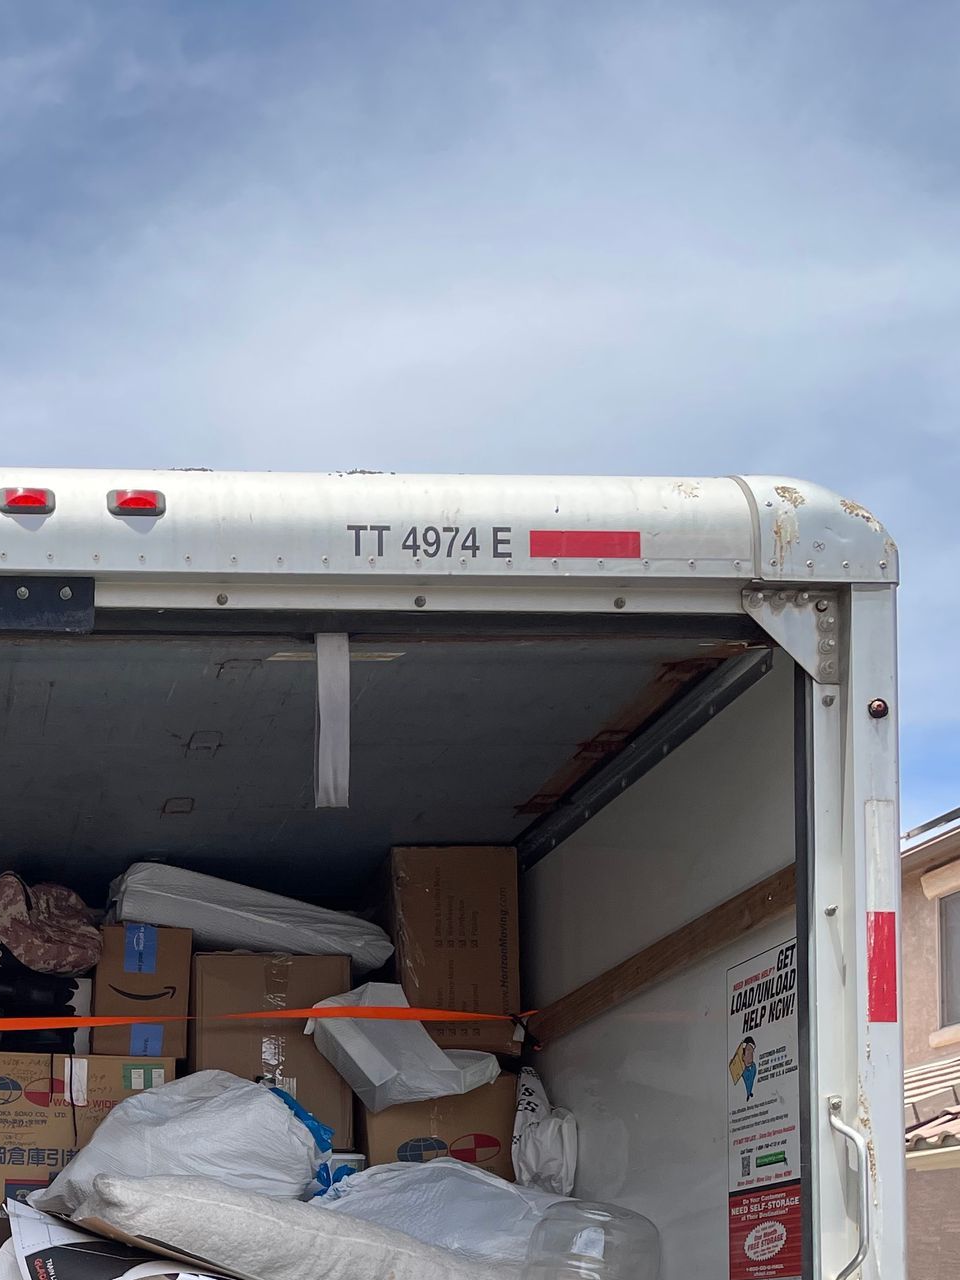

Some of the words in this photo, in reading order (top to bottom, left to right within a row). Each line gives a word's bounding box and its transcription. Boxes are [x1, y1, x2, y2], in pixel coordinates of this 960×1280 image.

[347, 525, 391, 557] TT
[401, 526, 480, 558] 4974
[493, 527, 512, 558] E
[777, 943, 796, 972] GET
[731, 968, 796, 1016] LOAD/UNLOAD
[742, 1005, 766, 1034] HELP
[768, 993, 795, 1023] NOW!
[517, 1099, 539, 1113] ES
[731, 1206, 748, 1216] NEED
[750, 1196, 800, 1212] SELF-STORAGE
[46, 1258, 55, 1276] TRAIN
